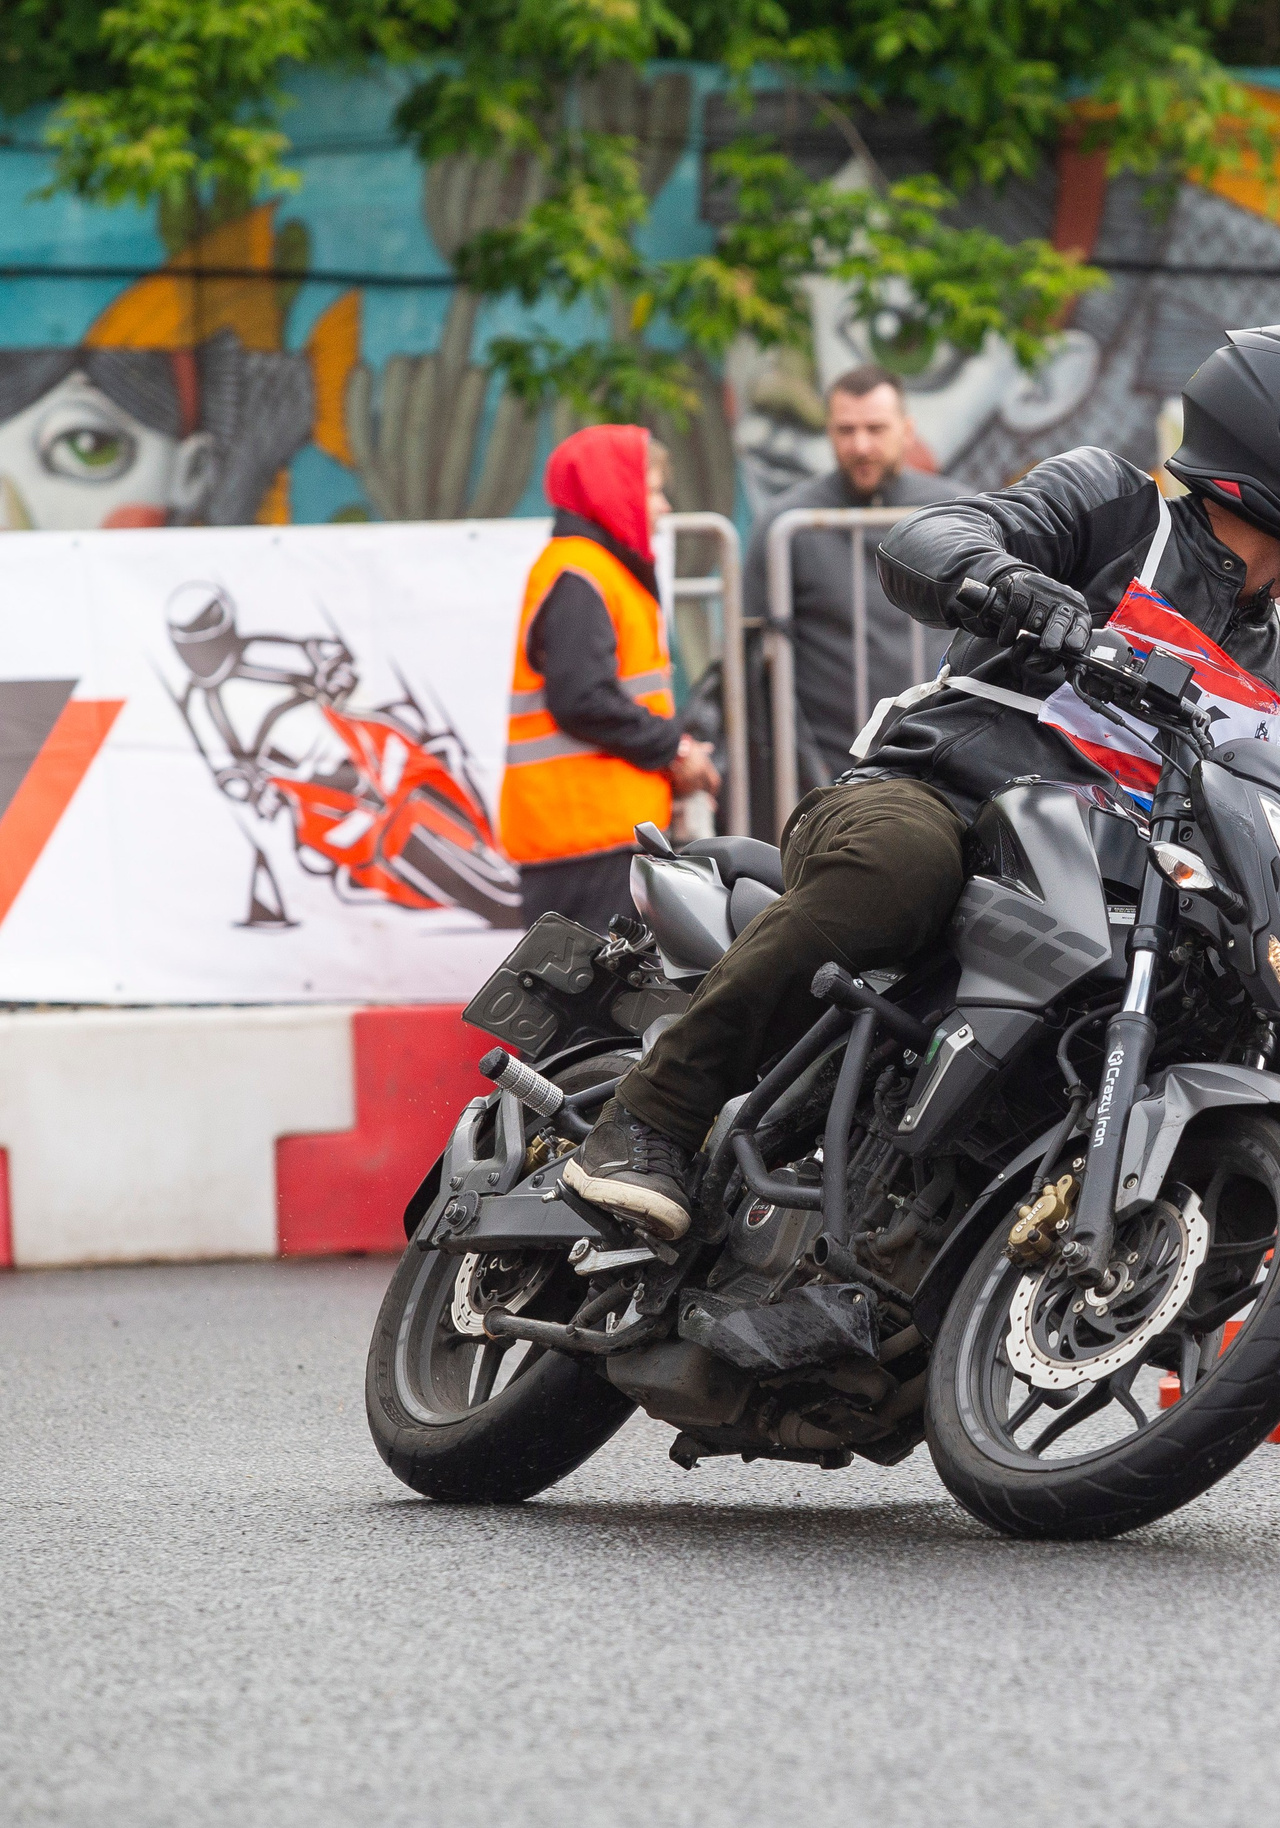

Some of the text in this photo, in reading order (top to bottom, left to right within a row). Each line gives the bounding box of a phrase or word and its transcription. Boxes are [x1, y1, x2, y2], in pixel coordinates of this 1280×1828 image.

[1093, 1067, 1120, 1147] Crazy Iron
[1015, 1201, 1045, 1233] BYBRE
